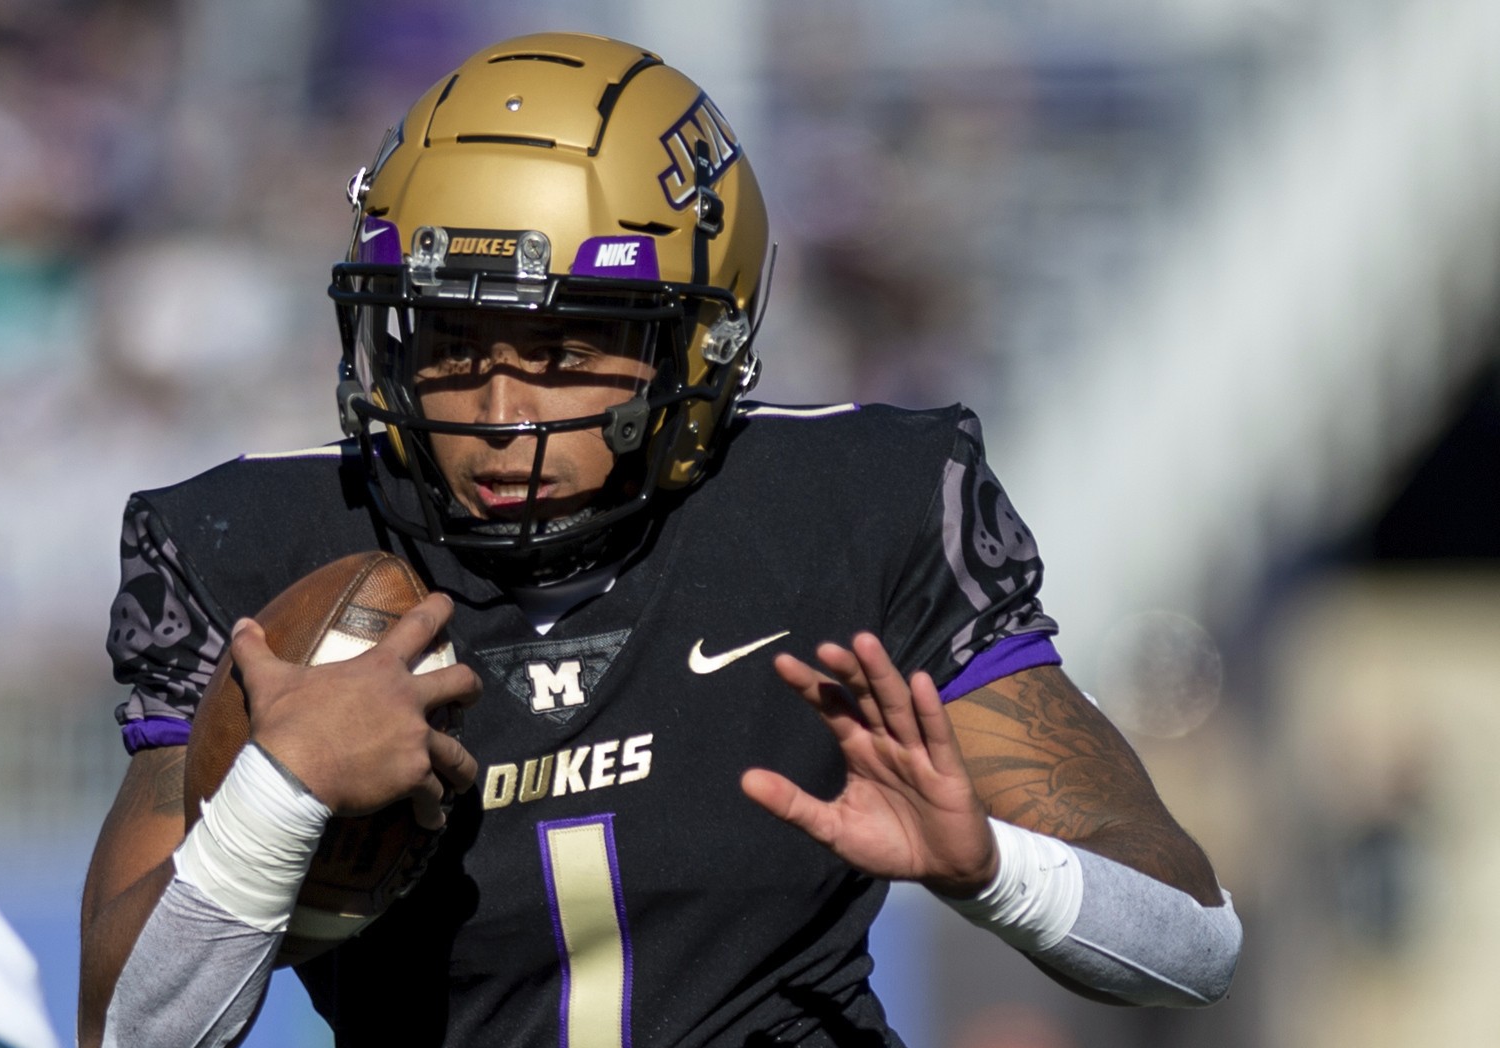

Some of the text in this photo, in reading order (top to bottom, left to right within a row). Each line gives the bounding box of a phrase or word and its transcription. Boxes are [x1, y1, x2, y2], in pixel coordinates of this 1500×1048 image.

[450, 237, 517, 257] DUKES
[594, 242, 640, 267] NIKE
[526, 659, 586, 711] M
[483, 733, 653, 810] DUKES
